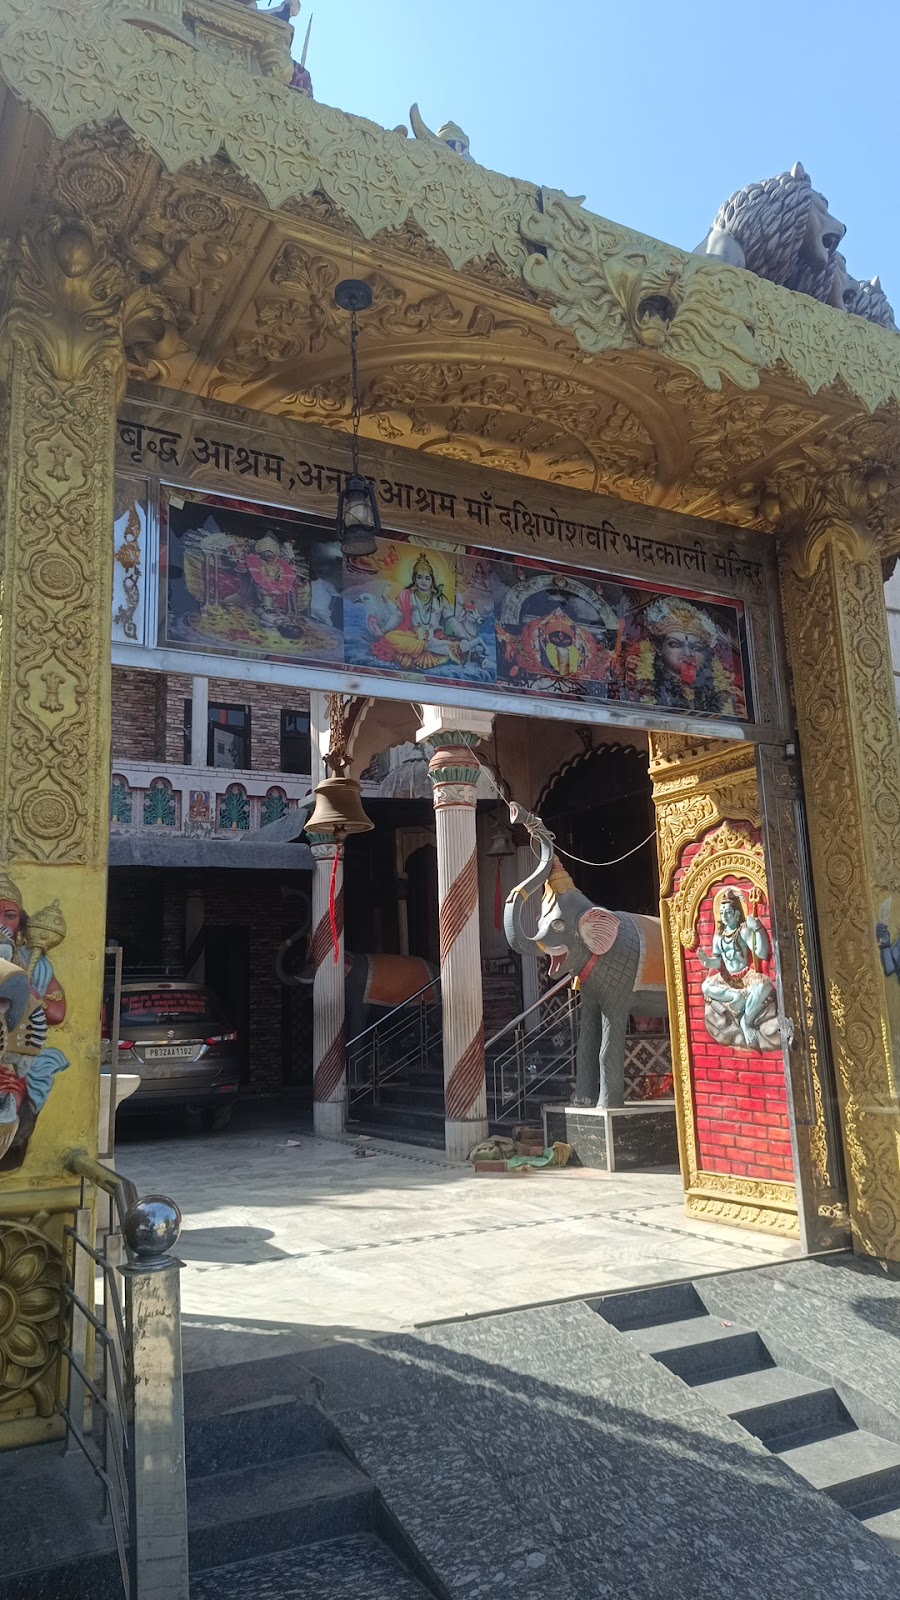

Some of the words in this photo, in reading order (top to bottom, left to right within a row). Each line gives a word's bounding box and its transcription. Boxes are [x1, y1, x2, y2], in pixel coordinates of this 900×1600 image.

[378, 479, 457, 519] आश्रम
[463, 490, 493, 526] माँ
[149, 1047, 193, 1057] PB32AA1102
